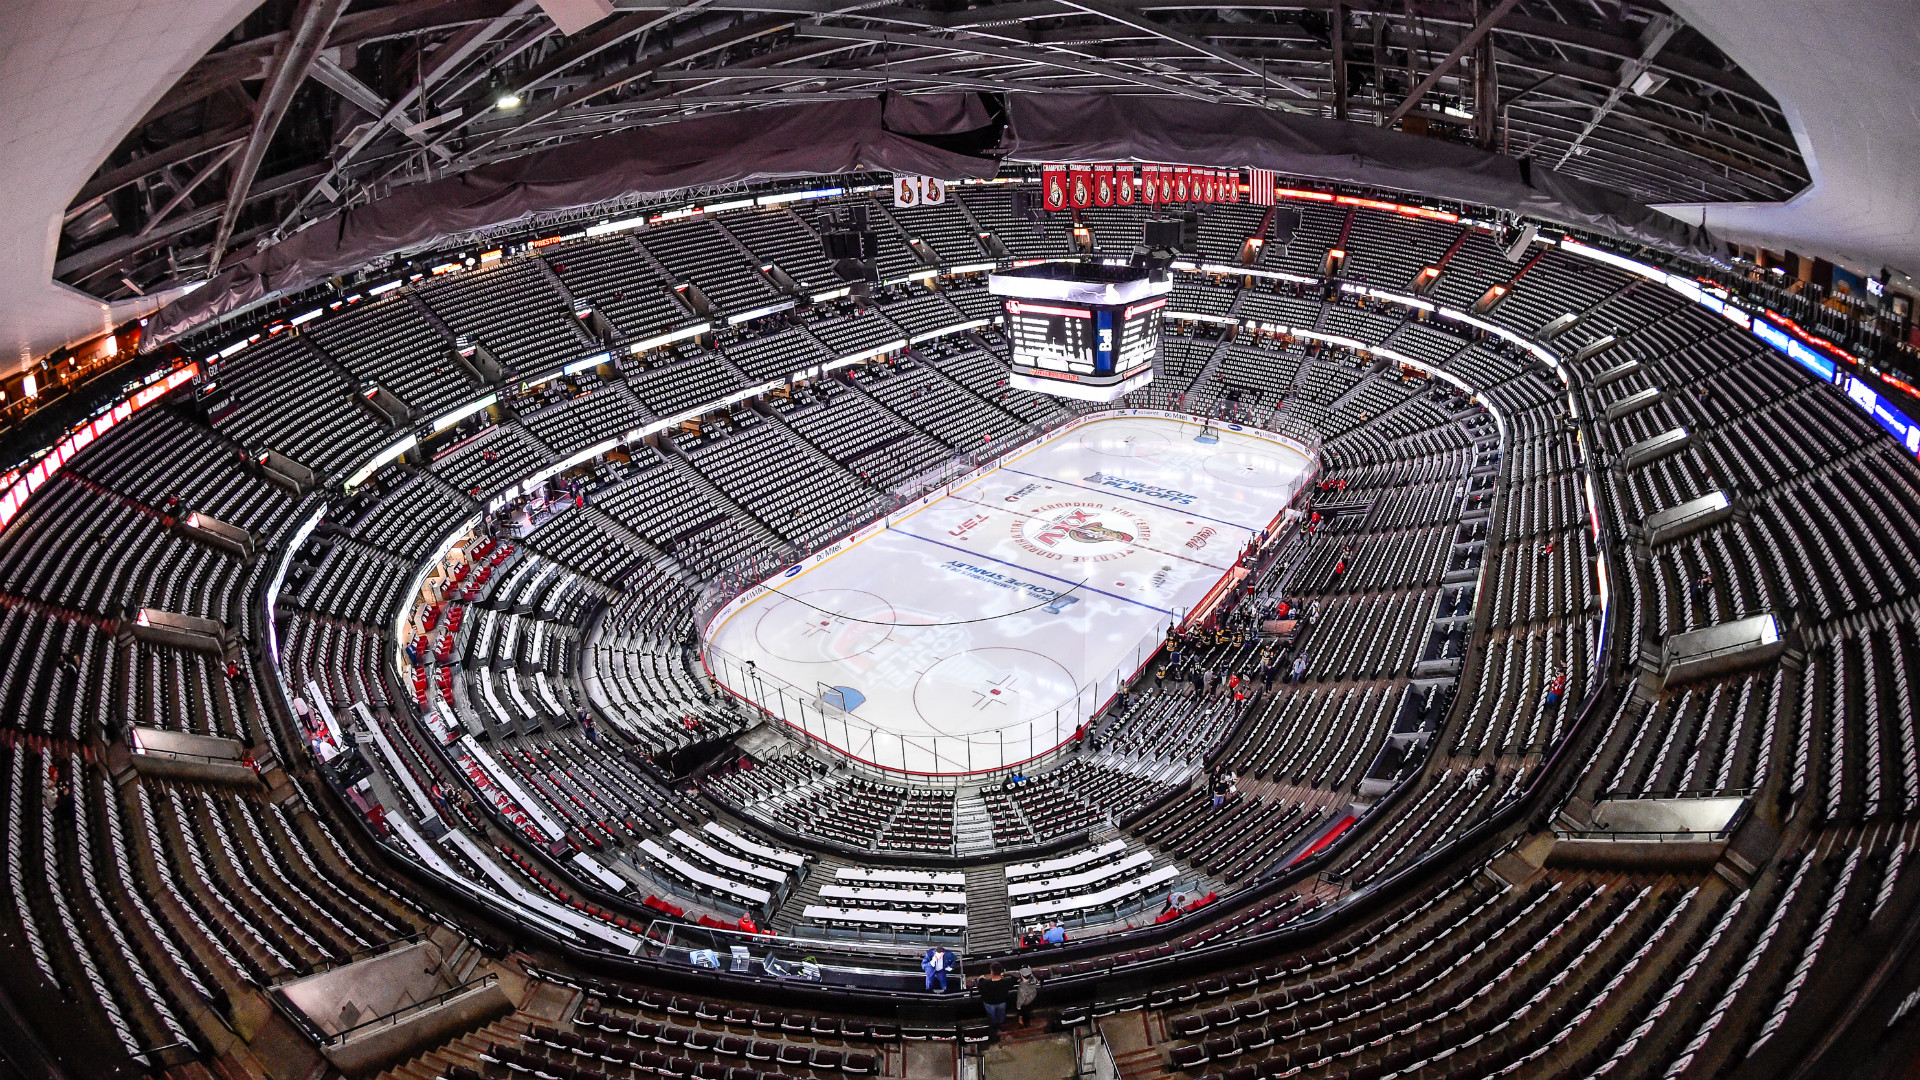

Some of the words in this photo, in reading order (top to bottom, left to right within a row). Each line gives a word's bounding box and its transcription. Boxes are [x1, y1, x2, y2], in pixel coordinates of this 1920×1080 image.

[1043, 164, 1067, 172] CHAMPIONS
[1069, 164, 1092, 172] CHAMPIONS
[534, 235, 561, 248] PRESTON
[1098, 328, 1113, 352] Bell
[1172, 412, 1188, 421] Mitel
[1102, 480, 1193, 506] PLAYOFFS
[1104, 475, 1168, 492] STANLEY
[1166, 490, 1198, 500] CUP
[1040, 501, 1104, 513] CANADIAN
[1110, 505, 1136, 519] TIRE
[824, 541, 842, 558] Mitel
[945, 560, 1006, 582] STANLEY
[1004, 577, 1056, 598] COUPE
